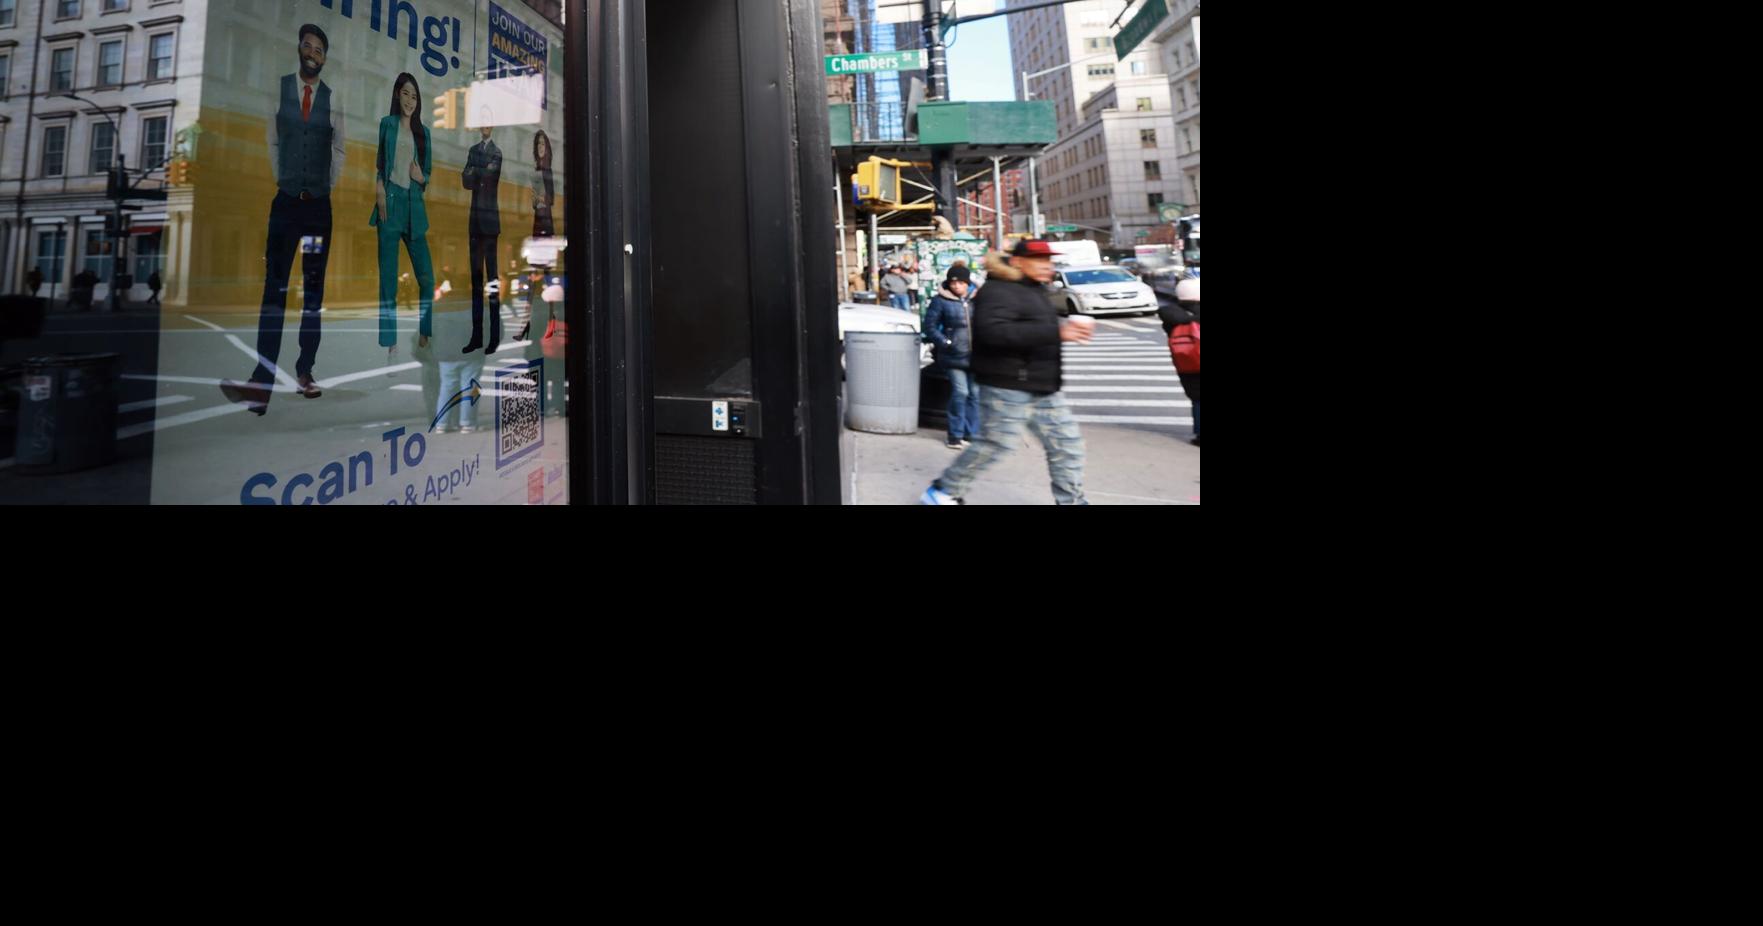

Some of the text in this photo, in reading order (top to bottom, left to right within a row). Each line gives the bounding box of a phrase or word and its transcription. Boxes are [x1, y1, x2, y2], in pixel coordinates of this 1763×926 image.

[320, 0, 461, 77] ing!
[492, 12, 545, 55] JOIN OUR
[492, 31, 545, 74] AMAZING
[831, 56, 899, 72] Chambers
[240, 426, 426, 505] Scan To
[405, 483, 417, 504] &
[423, 454, 480, 502] Apply!
